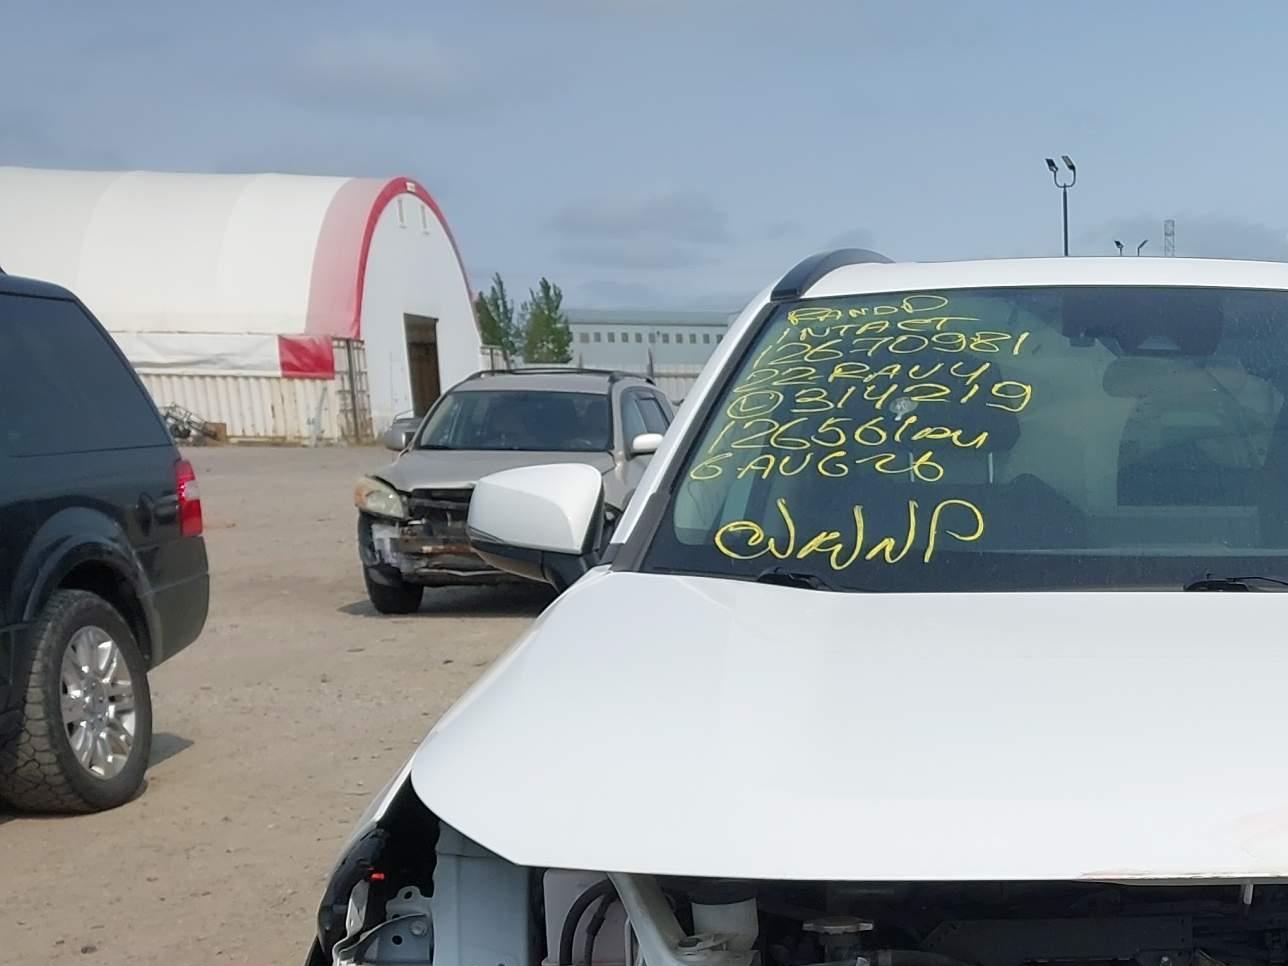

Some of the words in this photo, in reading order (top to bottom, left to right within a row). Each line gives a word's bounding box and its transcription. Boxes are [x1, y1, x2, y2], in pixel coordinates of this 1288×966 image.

[776, 316, 982, 344] INTACT
[752, 331, 1031, 369] 12670981
[732, 367, 824, 394] 22
